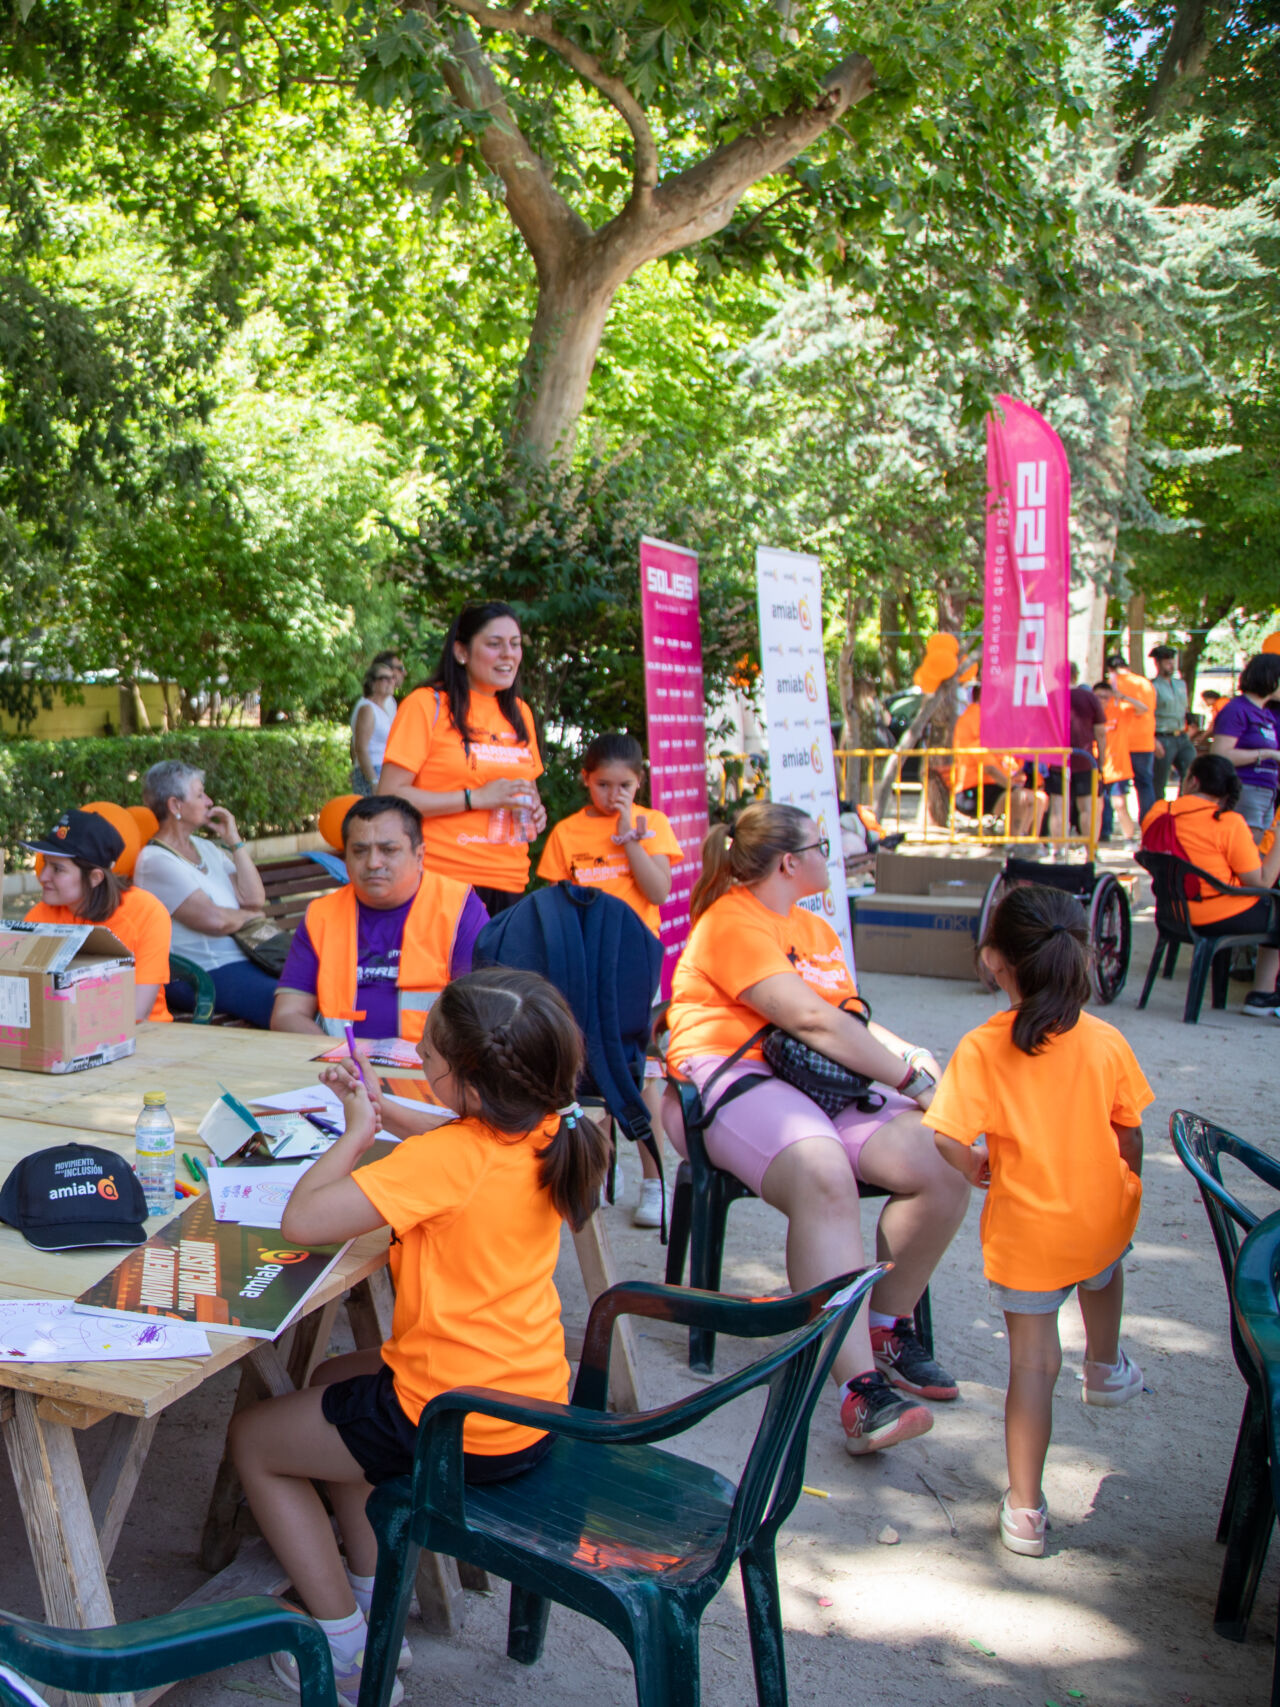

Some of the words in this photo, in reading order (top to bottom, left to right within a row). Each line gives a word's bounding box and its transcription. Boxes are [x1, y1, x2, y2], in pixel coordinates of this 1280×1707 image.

[647, 566, 694, 601] SOLISS
[771, 600, 799, 620] amiab
[777, 672, 804, 693] amiab
[782, 747, 811, 768] amiab
[55, 1158, 95, 1171] MOVIMIENTO
[64, 1164, 103, 1178] INCLUSIÓN
[49, 1181, 97, 1200] amiab
[140, 1247, 175, 1309] MOVIMIENTO
[172, 1239, 217, 1297] INCLUSIÓN
[239, 1264, 284, 1299] amiab
[178, 1300, 195, 1312] POR
